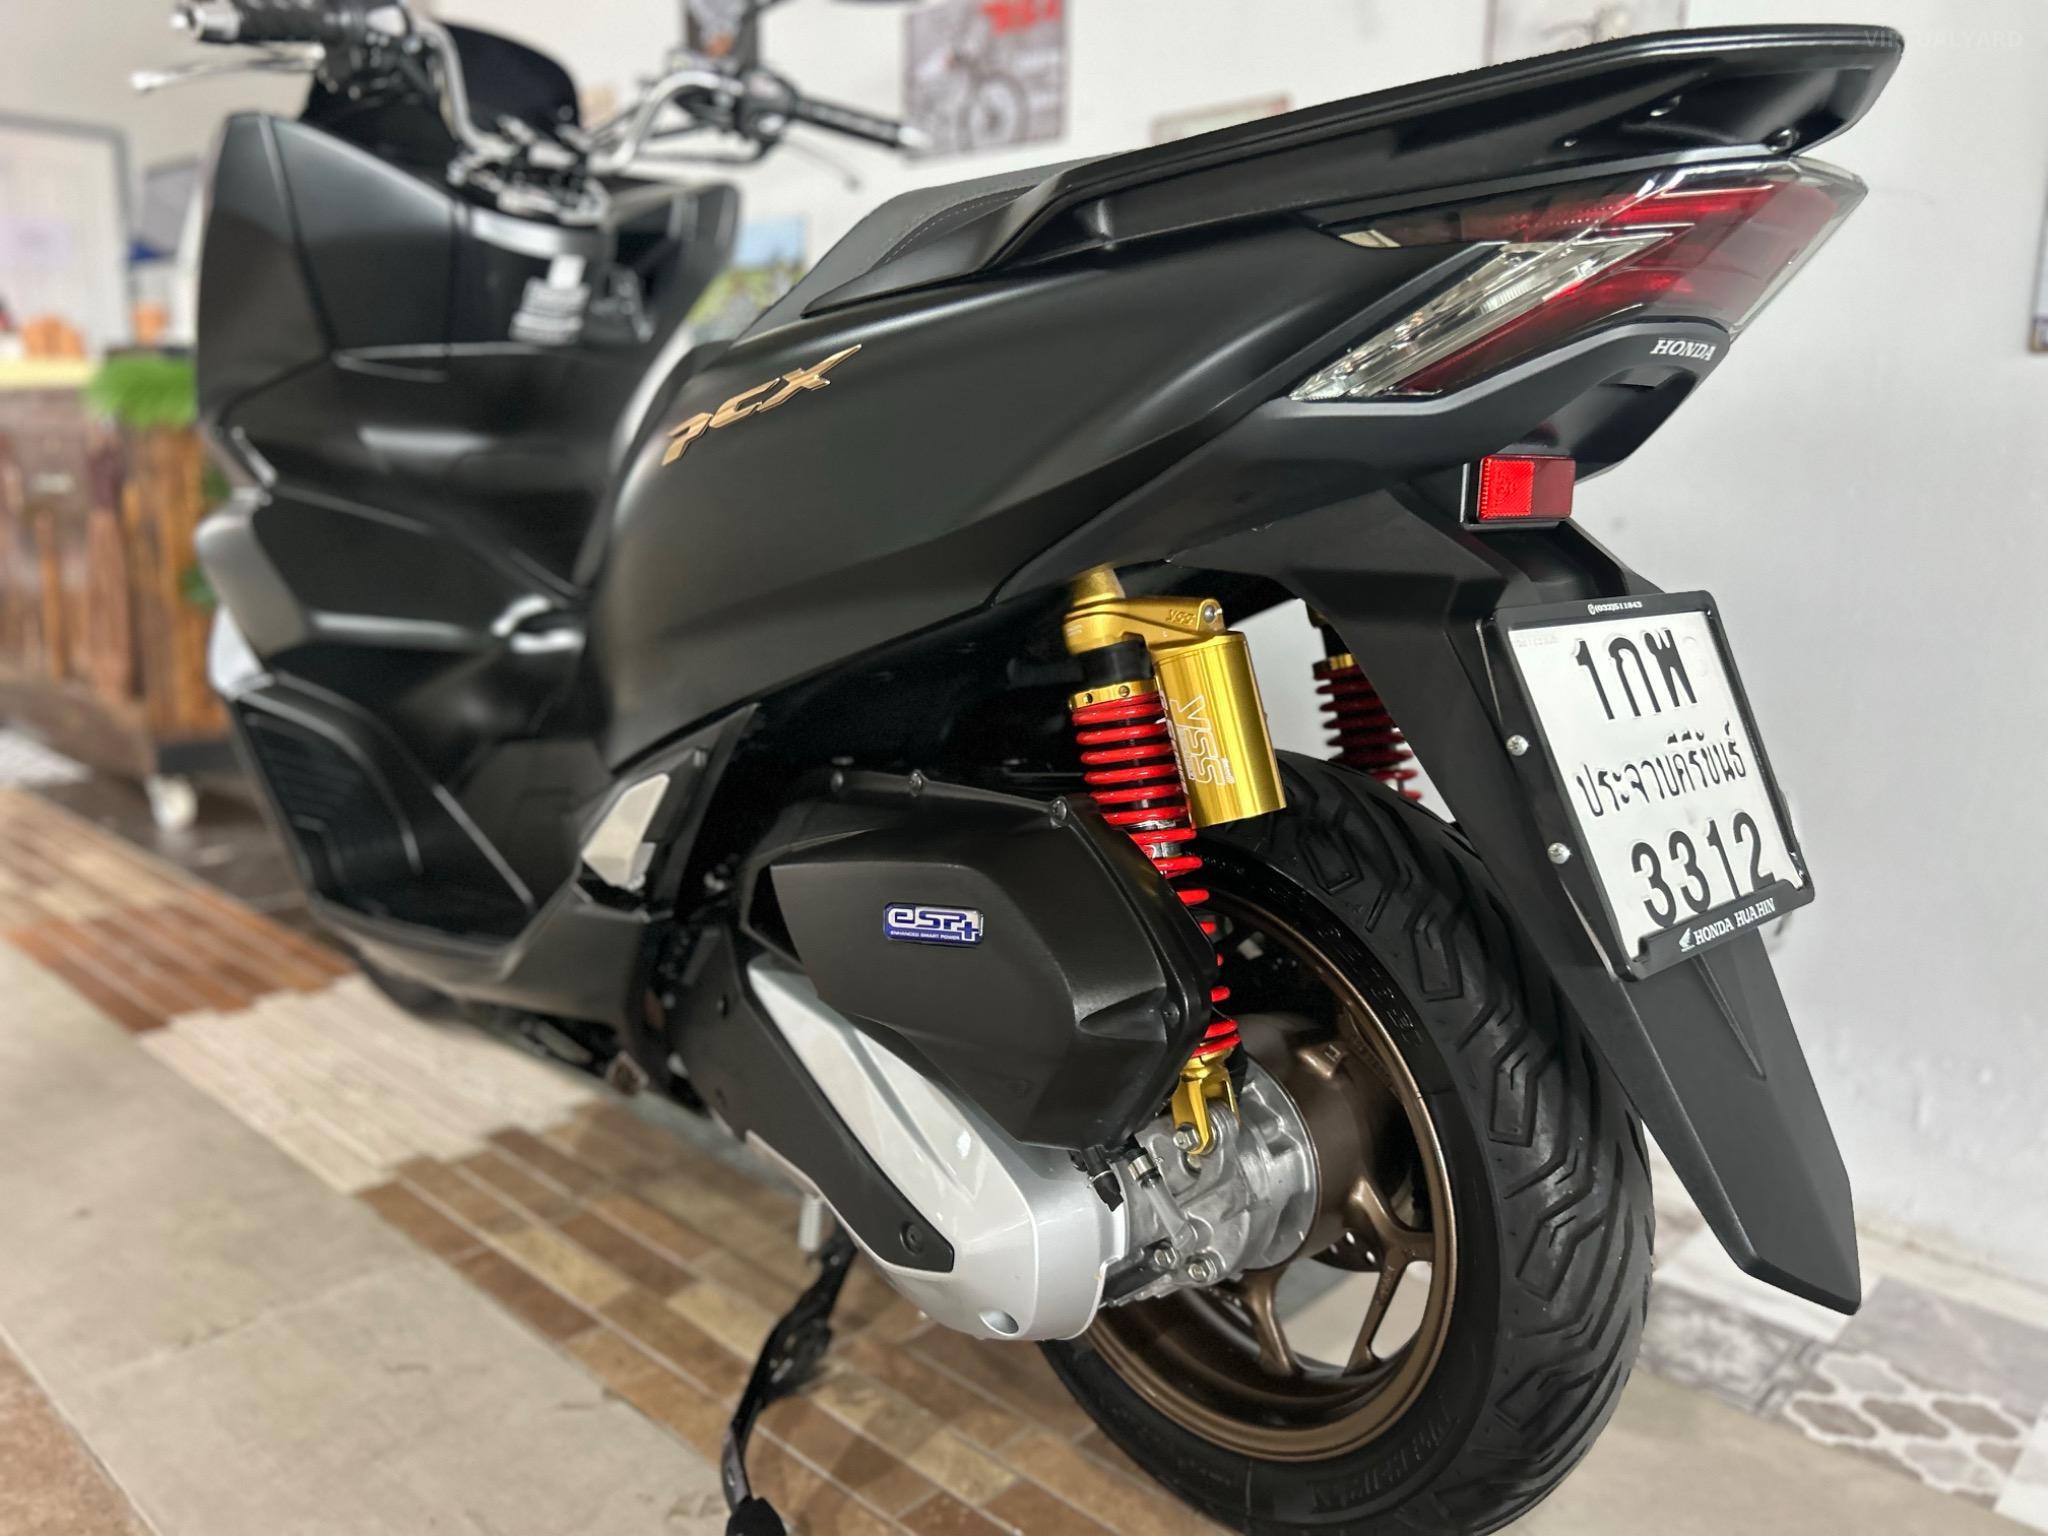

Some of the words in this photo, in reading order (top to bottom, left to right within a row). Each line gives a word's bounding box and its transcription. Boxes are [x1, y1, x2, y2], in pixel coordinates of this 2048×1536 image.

[1649, 339, 1716, 361] HONDA
[661, 344, 863, 466] PCX
[1169, 694, 1226, 786] YSS
[1631, 811, 1776, 928] 3312
[1693, 917, 1735, 945] HONDA
[1733, 905, 1759, 927] HUA
[1755, 897, 1776, 918] HIN
